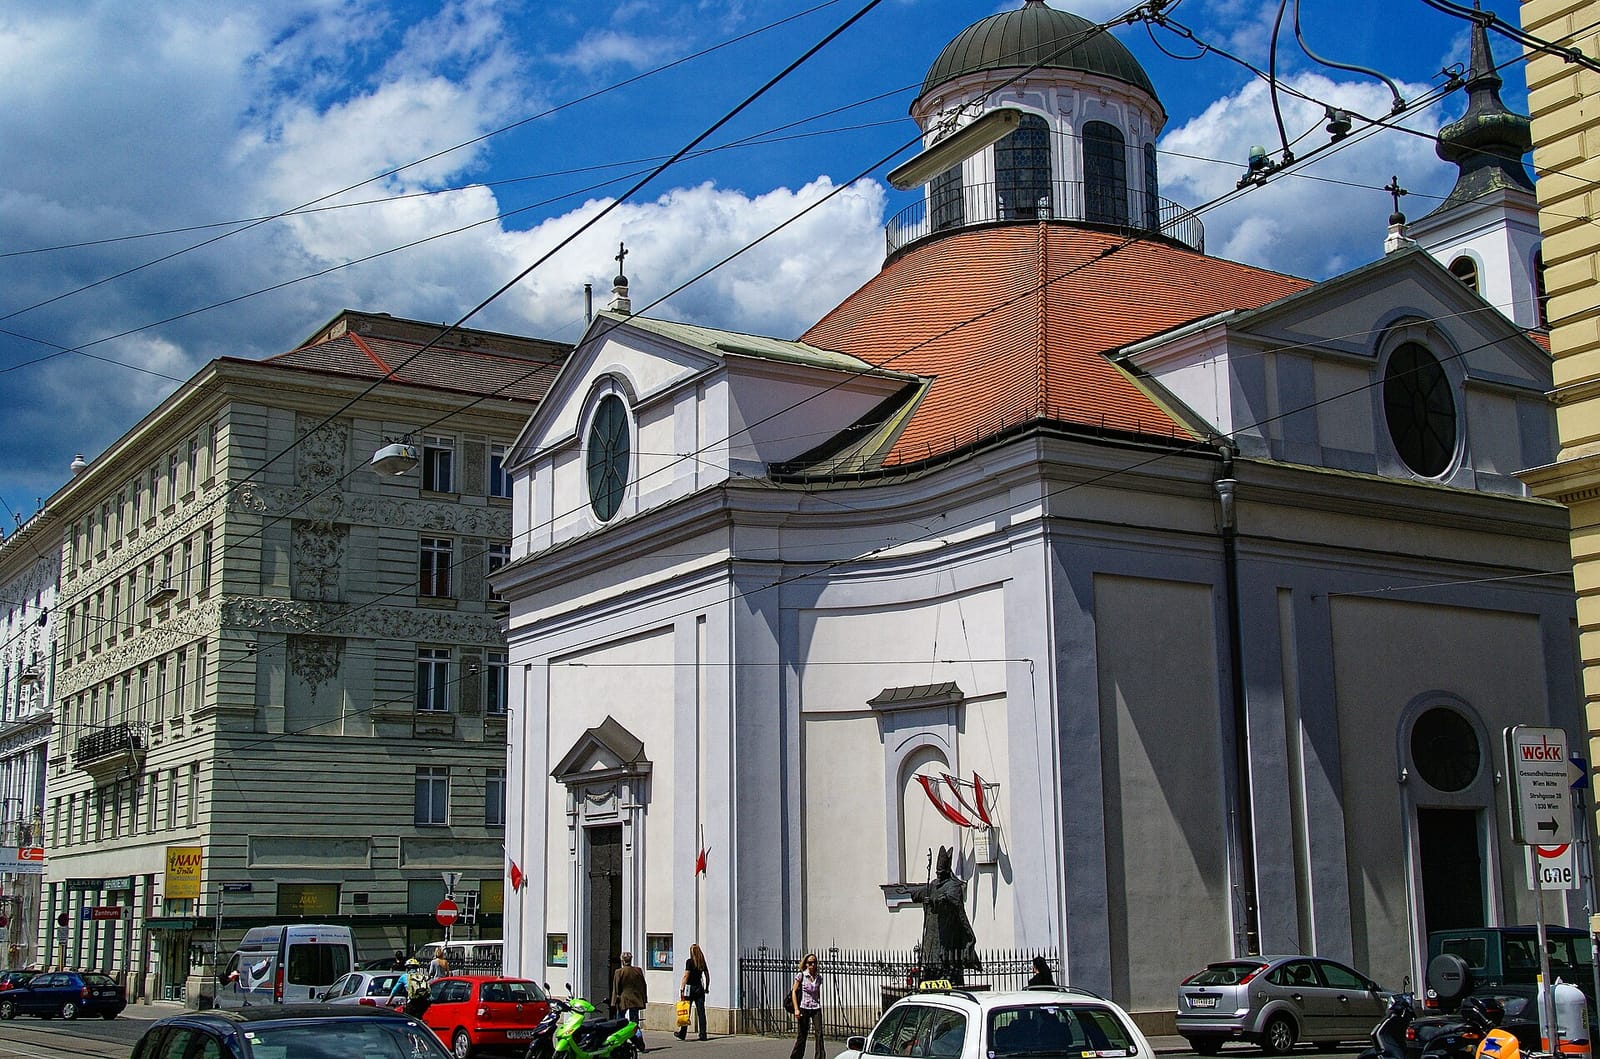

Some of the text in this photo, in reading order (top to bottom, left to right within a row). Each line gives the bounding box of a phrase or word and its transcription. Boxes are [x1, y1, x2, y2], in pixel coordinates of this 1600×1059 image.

[1522, 738, 1562, 760] WGKK
[1519, 770, 1568, 778] Gesundheitszentrum
[175, 854, 201, 866] NAN
[94, 909, 119, 917] Zentrum
[925, 980, 949, 989] TAXI
